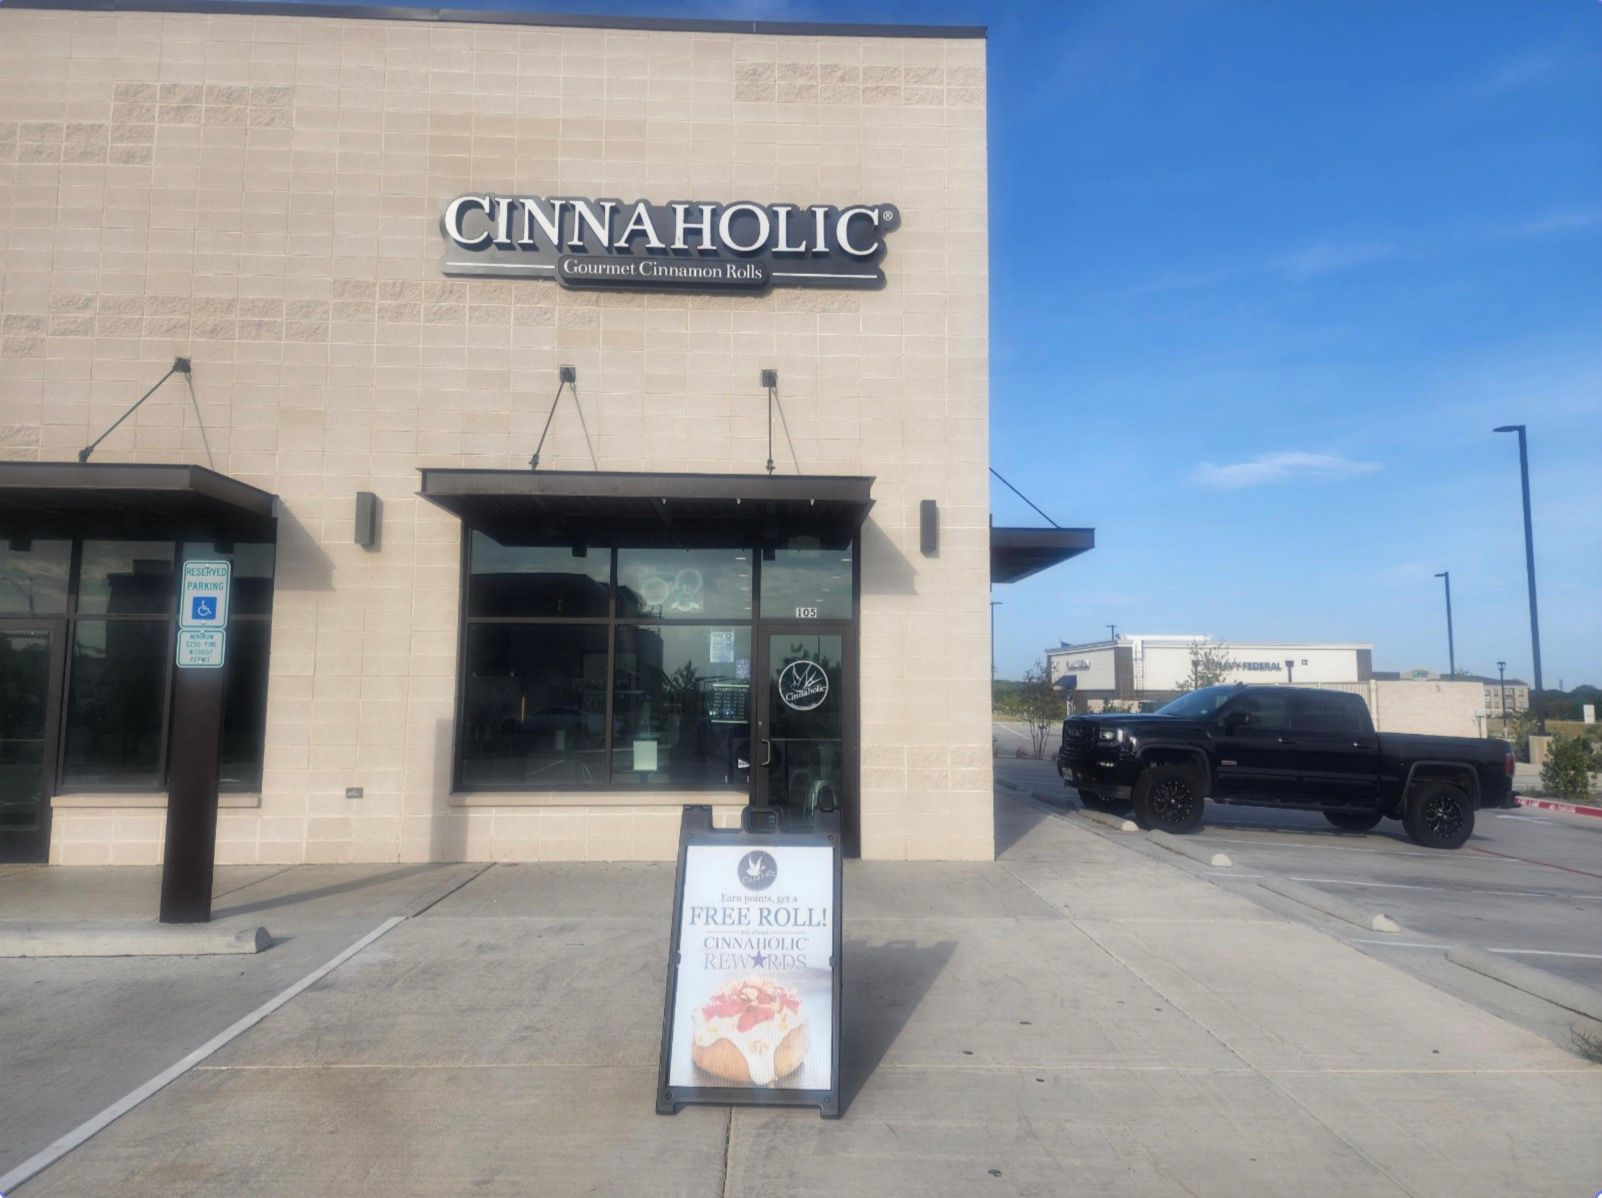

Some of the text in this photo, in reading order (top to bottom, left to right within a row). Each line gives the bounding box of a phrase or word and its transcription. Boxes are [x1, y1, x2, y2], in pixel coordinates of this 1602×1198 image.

[444, 196, 879, 256] CINNAHOLIC
[563, 258, 763, 280] Gourmet Cinnamon Rolls
[186, 567, 227, 577] RESERVED
[187, 581, 224, 591] PARKING
[797, 608, 816, 617] 105
[1242, 661, 1282, 672] FEDERAL
[785, 684, 826, 701] Cinnaholic
[721, 893, 742, 903] Earn
[744, 893, 775, 905] points,
[776, 895, 790, 905] get
[689, 906, 827, 927] FREE ROLL!
[703, 936, 806, 951] CINNAHOLIC
